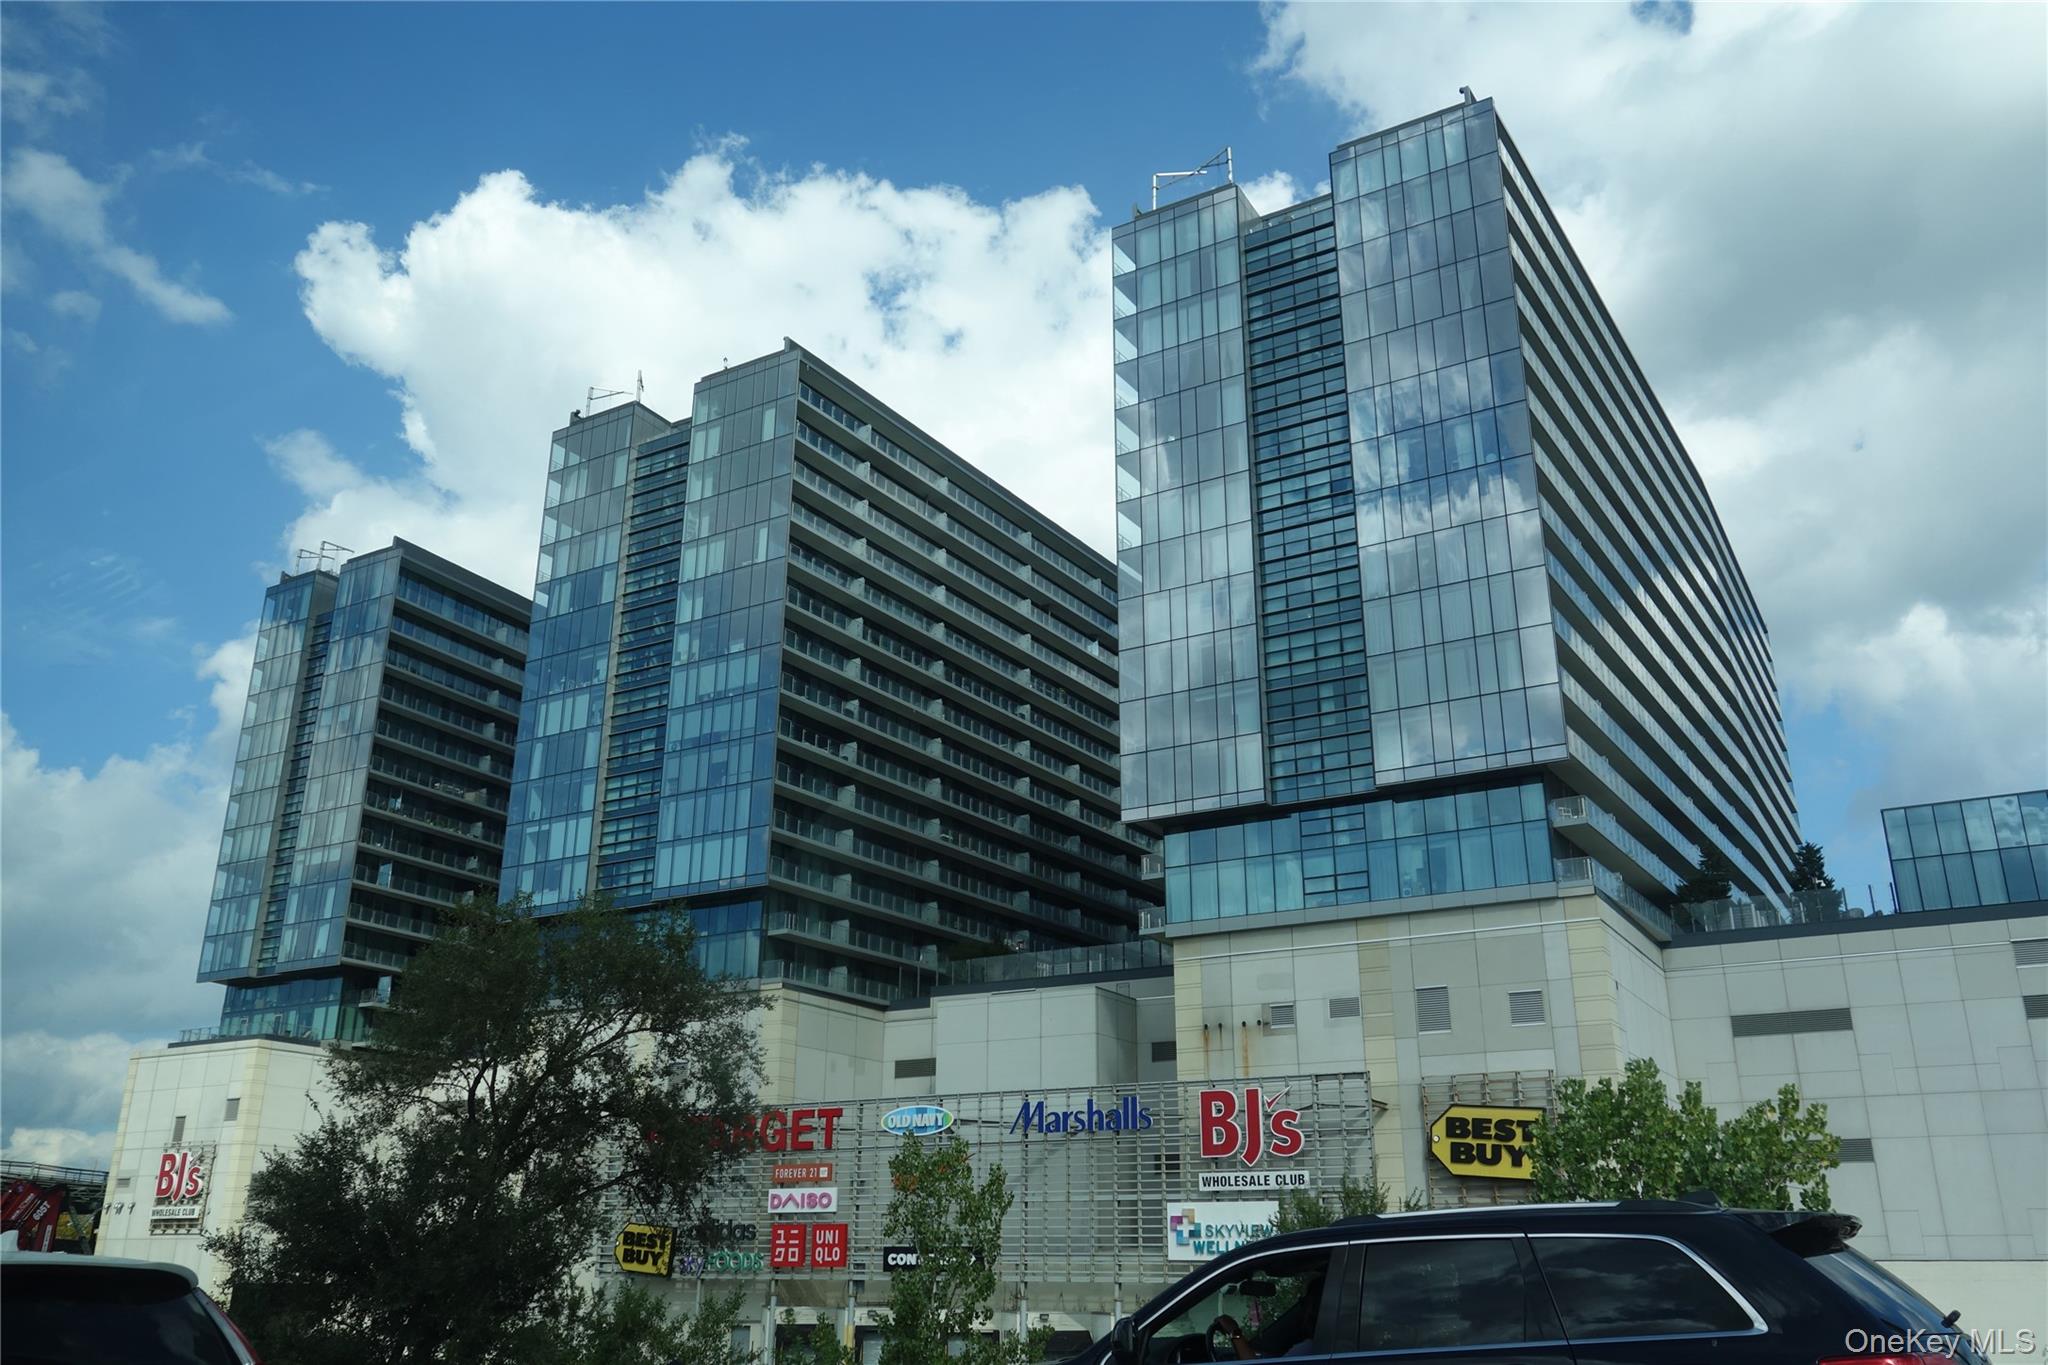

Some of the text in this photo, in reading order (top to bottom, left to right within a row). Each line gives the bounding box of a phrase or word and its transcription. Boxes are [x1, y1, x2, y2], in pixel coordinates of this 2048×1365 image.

[888, 1114, 944, 1128] OLD NAVY
[1010, 1096, 1153, 1135] Marshalls
[1446, 1117, 1537, 1142] BEST
[1450, 1142, 1527, 1168] BUY
[775, 1168, 807, 1178] FOREVER
[809, 1168, 818, 1178] 21
[1201, 1174, 1305, 1187] WHOLESALE CLUB
[770, 1192, 832, 1210] DAISO
[151, 1208, 196, 1217] WHOLESALE CLUB
[815, 1229, 839, 1245] UNI
[1205, 1224, 1274, 1238] SKYVIEW
[623, 1231, 670, 1249] BEST
[623, 1248, 664, 1266] BUY
[815, 1247, 840, 1263] QLO
